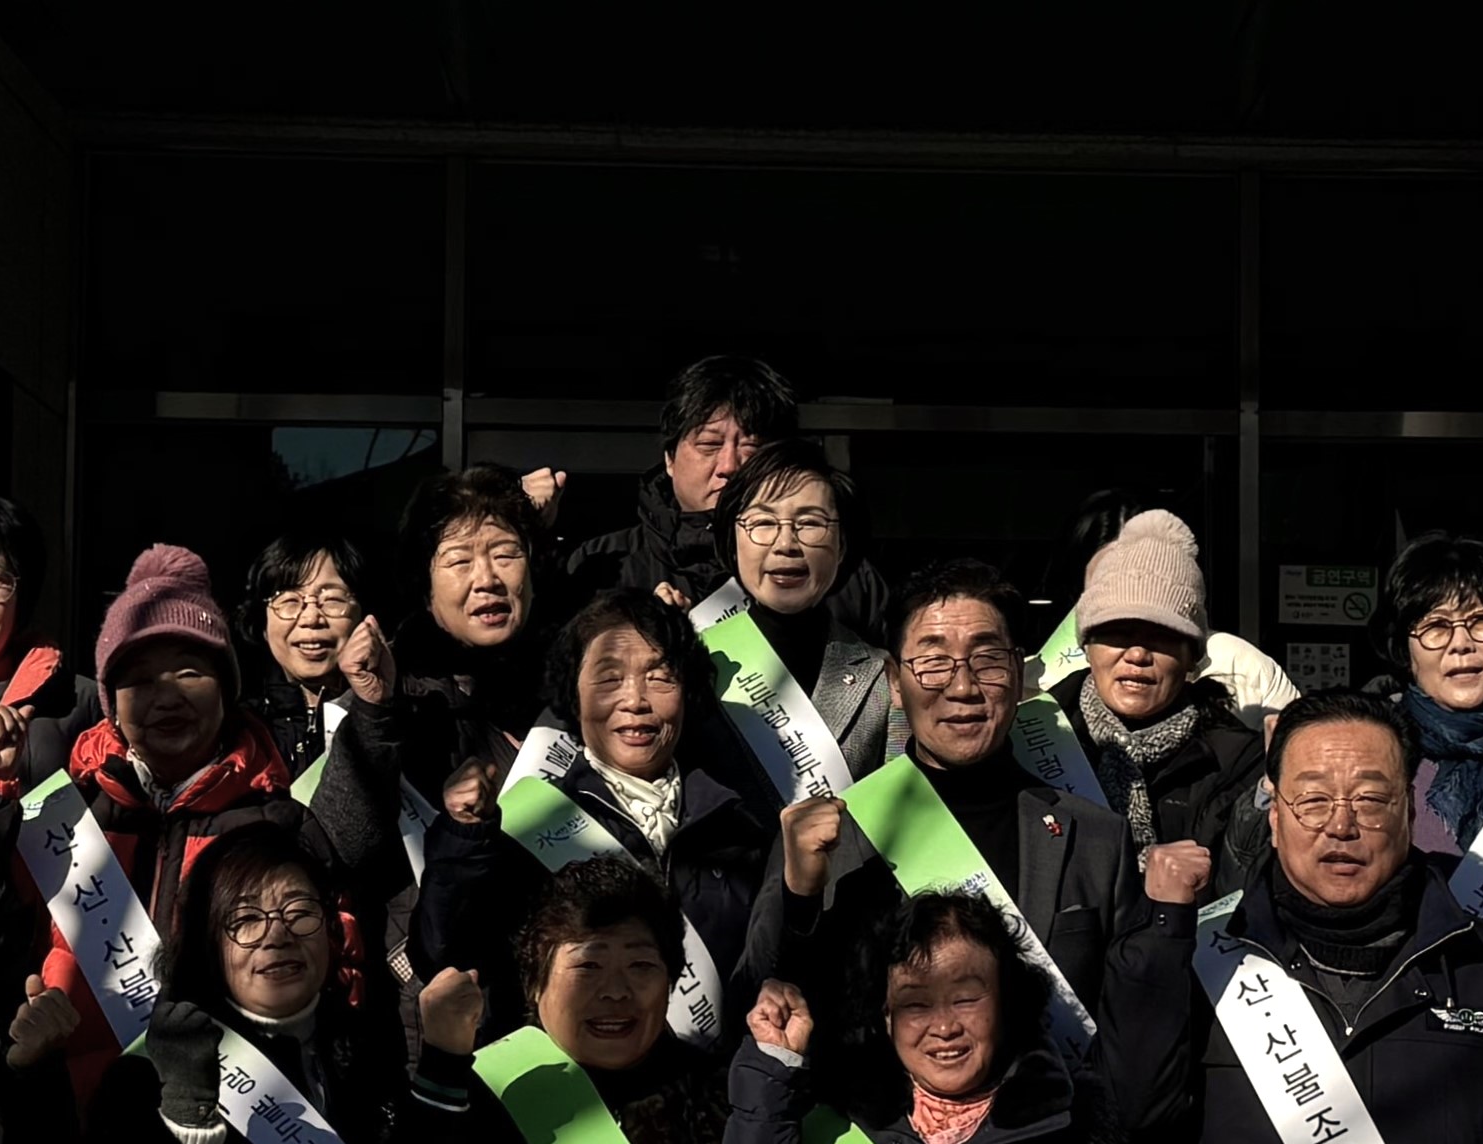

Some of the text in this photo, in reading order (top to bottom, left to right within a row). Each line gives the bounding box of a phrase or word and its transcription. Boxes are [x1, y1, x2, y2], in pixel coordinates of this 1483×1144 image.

[1312, 568, 1371, 585] 금연구역
[735, 672, 791, 730] 논두렁
[1016, 716, 1064, 785] 논두렁
